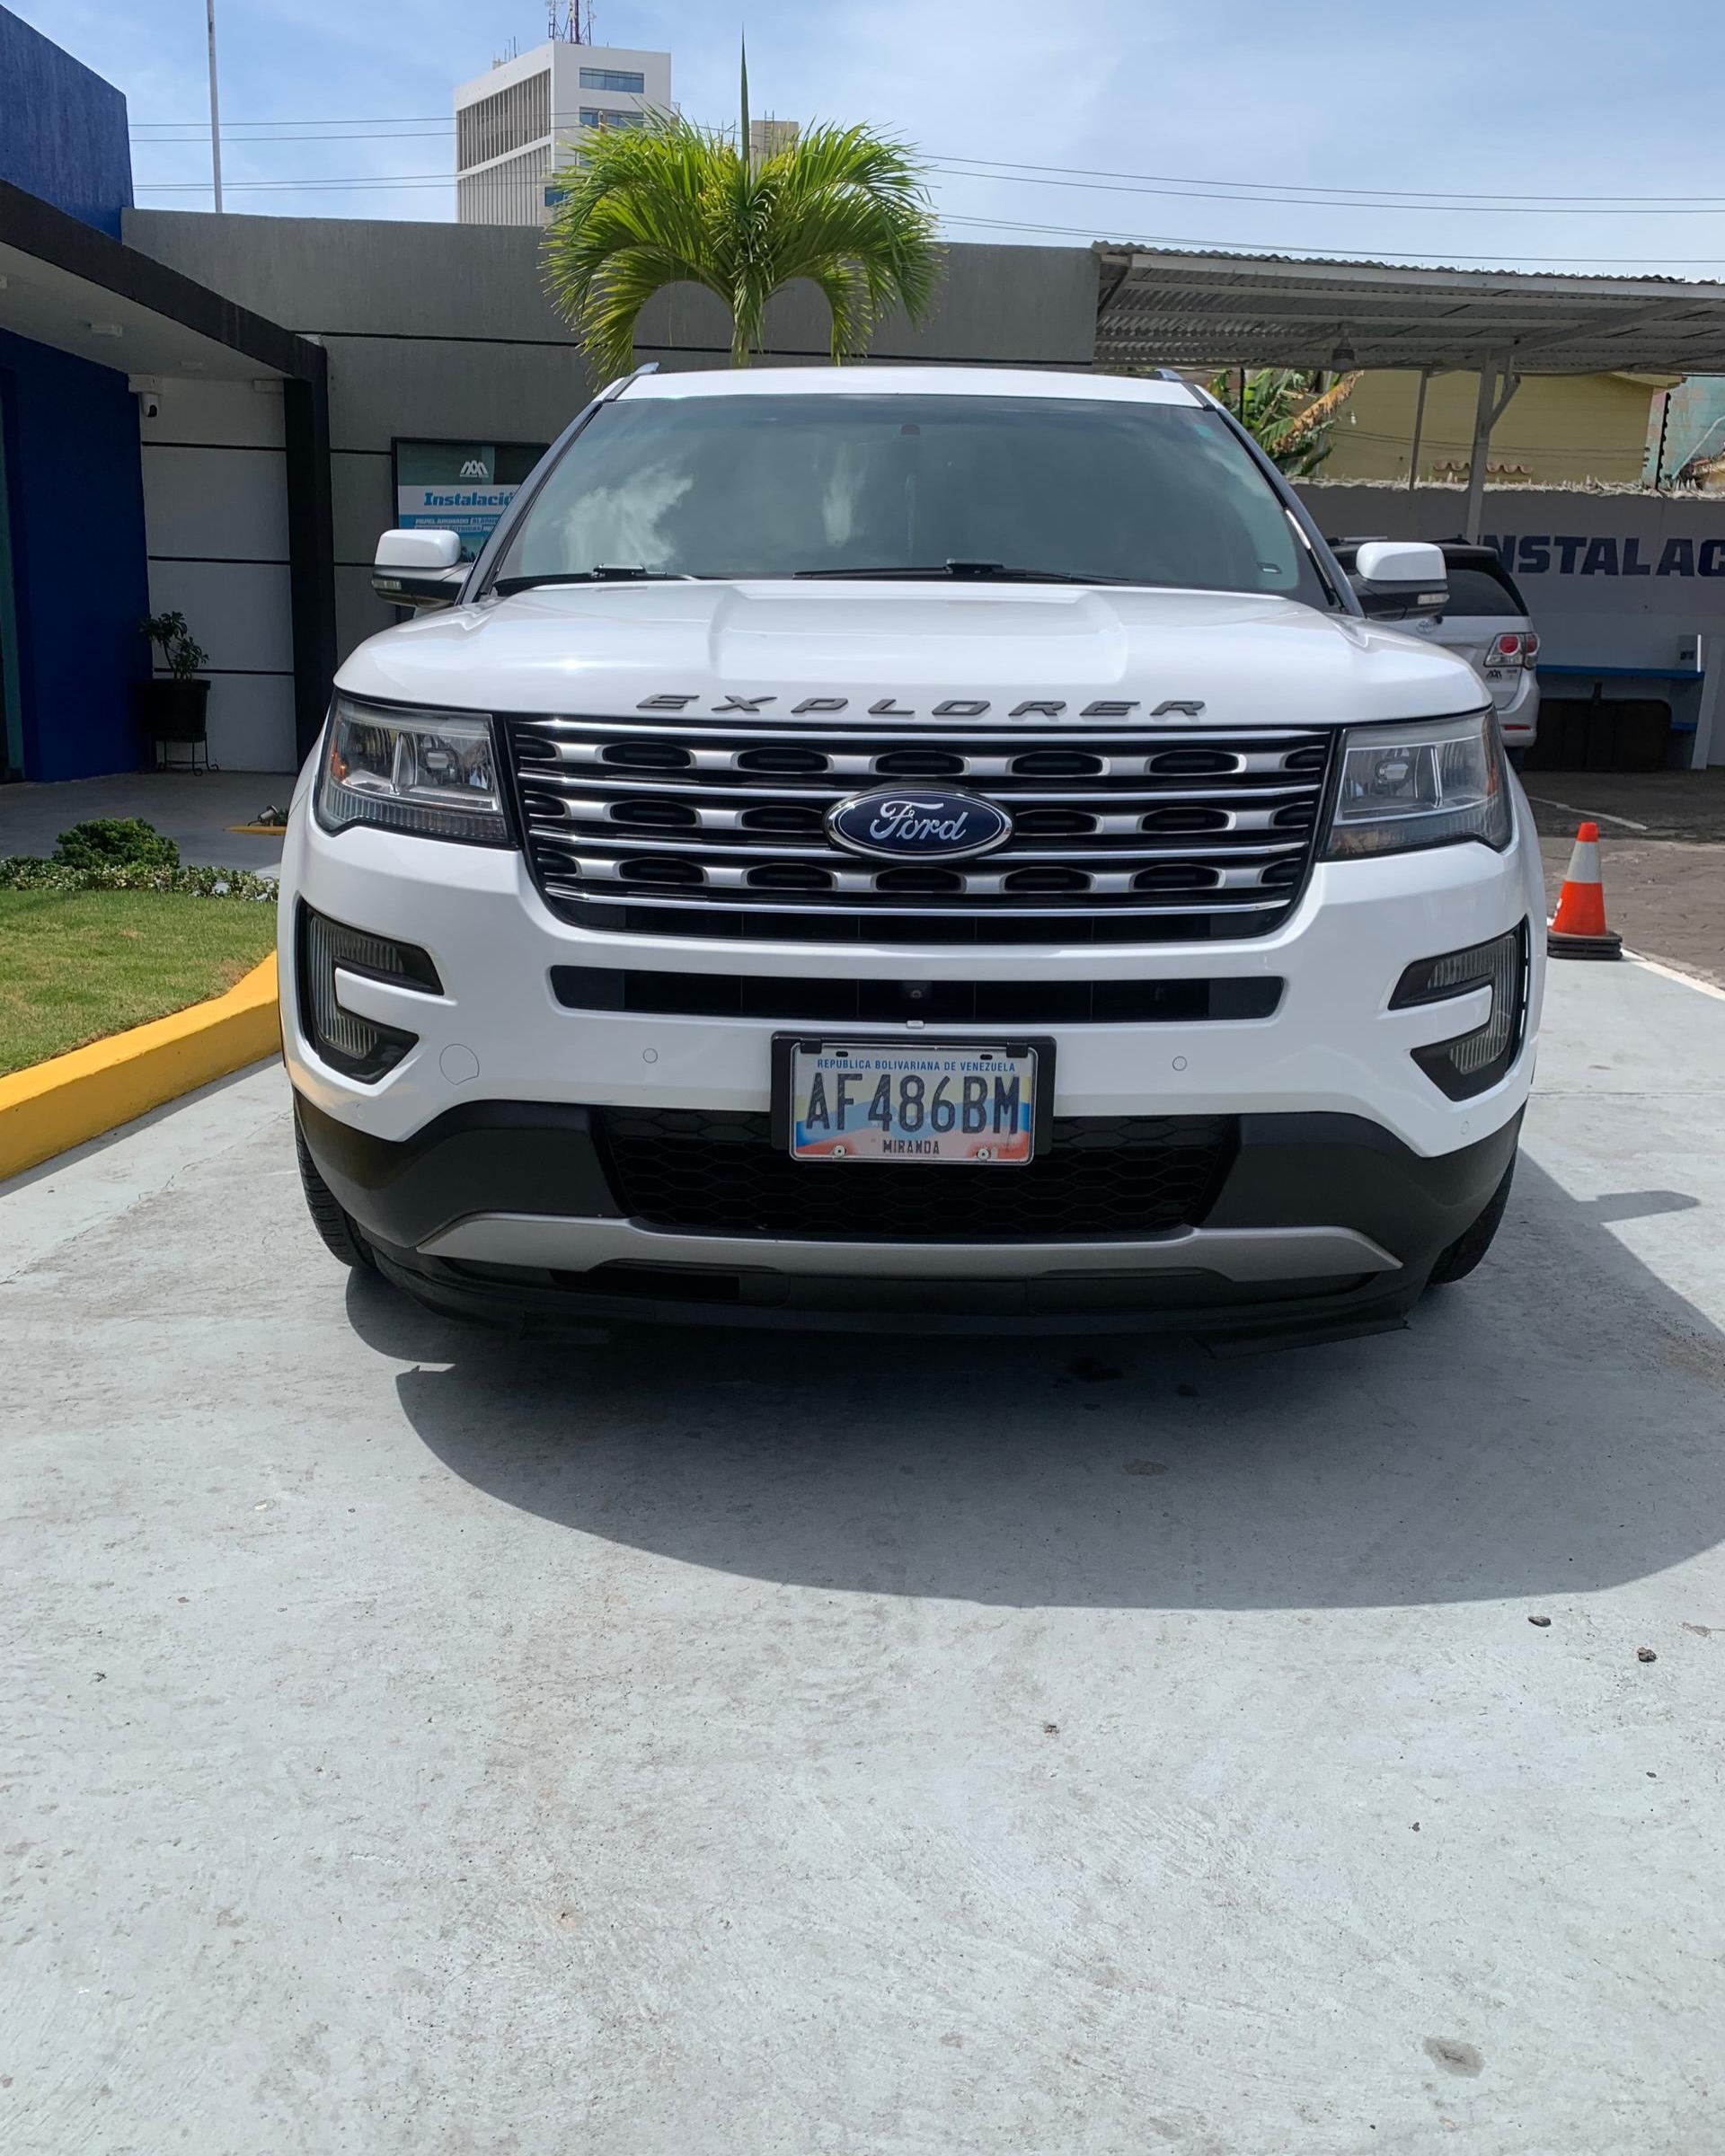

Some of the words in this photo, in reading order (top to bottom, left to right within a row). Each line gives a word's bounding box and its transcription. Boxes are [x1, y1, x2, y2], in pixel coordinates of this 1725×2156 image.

[1477, 535, 1725, 577] NSTALAC
[636, 694, 1207, 717] EXPLORER
[870, 800, 969, 840] Ford
[817, 1058, 871, 1070] REPUBLICA
[875, 1060, 941, 1072] BOLIVARIANA
[944, 1060, 957, 1071] DE
[960, 1061, 1015, 1073] VENEZUELA
[806, 1072, 1020, 1135] AF486BM
[882, 1139, 940, 1154] MIRANDA
